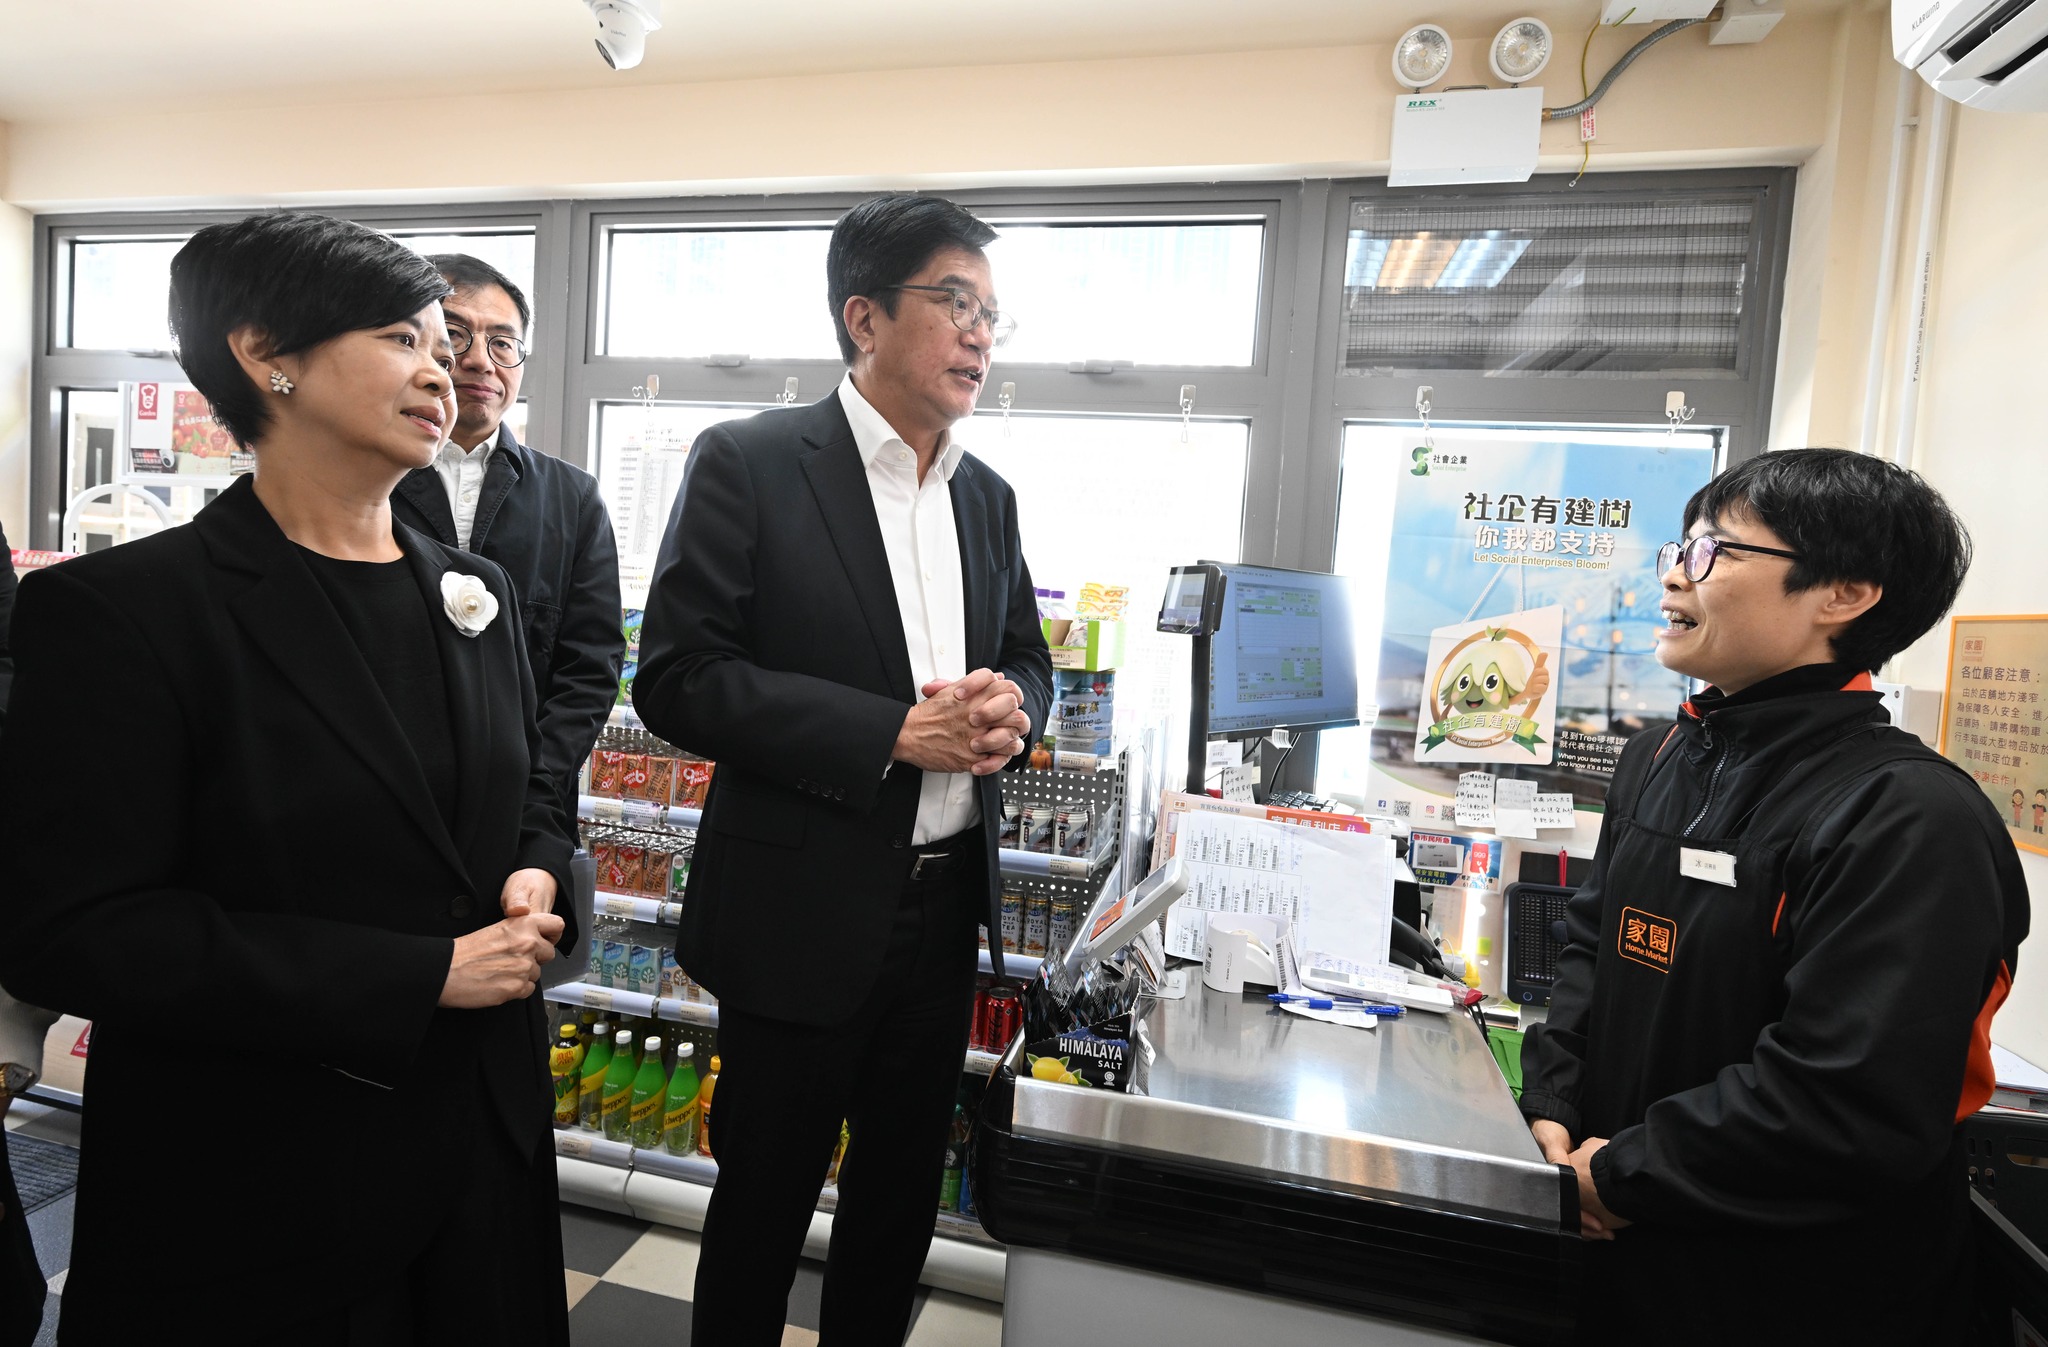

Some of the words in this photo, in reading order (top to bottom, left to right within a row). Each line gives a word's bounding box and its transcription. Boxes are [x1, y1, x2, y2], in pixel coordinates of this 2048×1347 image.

[1911, 1, 1940, 31] KLARWIND
[1407, 99, 1437, 107] REX
[138, 409, 157, 417] Garden
[1432, 454, 1468, 465] 社會企業
[1463, 491, 1633, 529] 社企有建樹
[1474, 525, 1616, 557] 你我都支持
[1474, 552, 1489, 563] Let
[1491, 553, 1519, 565] Social
[1521, 555, 1574, 570] Enterprises
[1575, 559, 1611, 570] Bloom!
[1964, 640, 1983, 651] 家園
[1060, 719, 1095, 731] Ensure
[1442, 714, 1521, 733] 社企有建樹
[1456, 737, 1468, 745] Social
[1560, 730, 1629, 745] 見到Tree嘜標誌
[1558, 752, 1576, 760] When
[683, 768, 695, 785] 9
[694, 775, 710, 783] PACKS
[1625, 918, 1670, 953] 家園
[1625, 942, 1645, 955] Home
[1645, 948, 1669, 964] Market
[1059, 1037, 1123, 1061] HIMALAYA
[1097, 1060, 1123, 1070] SALT
[603, 1093, 627, 1112] weppes
